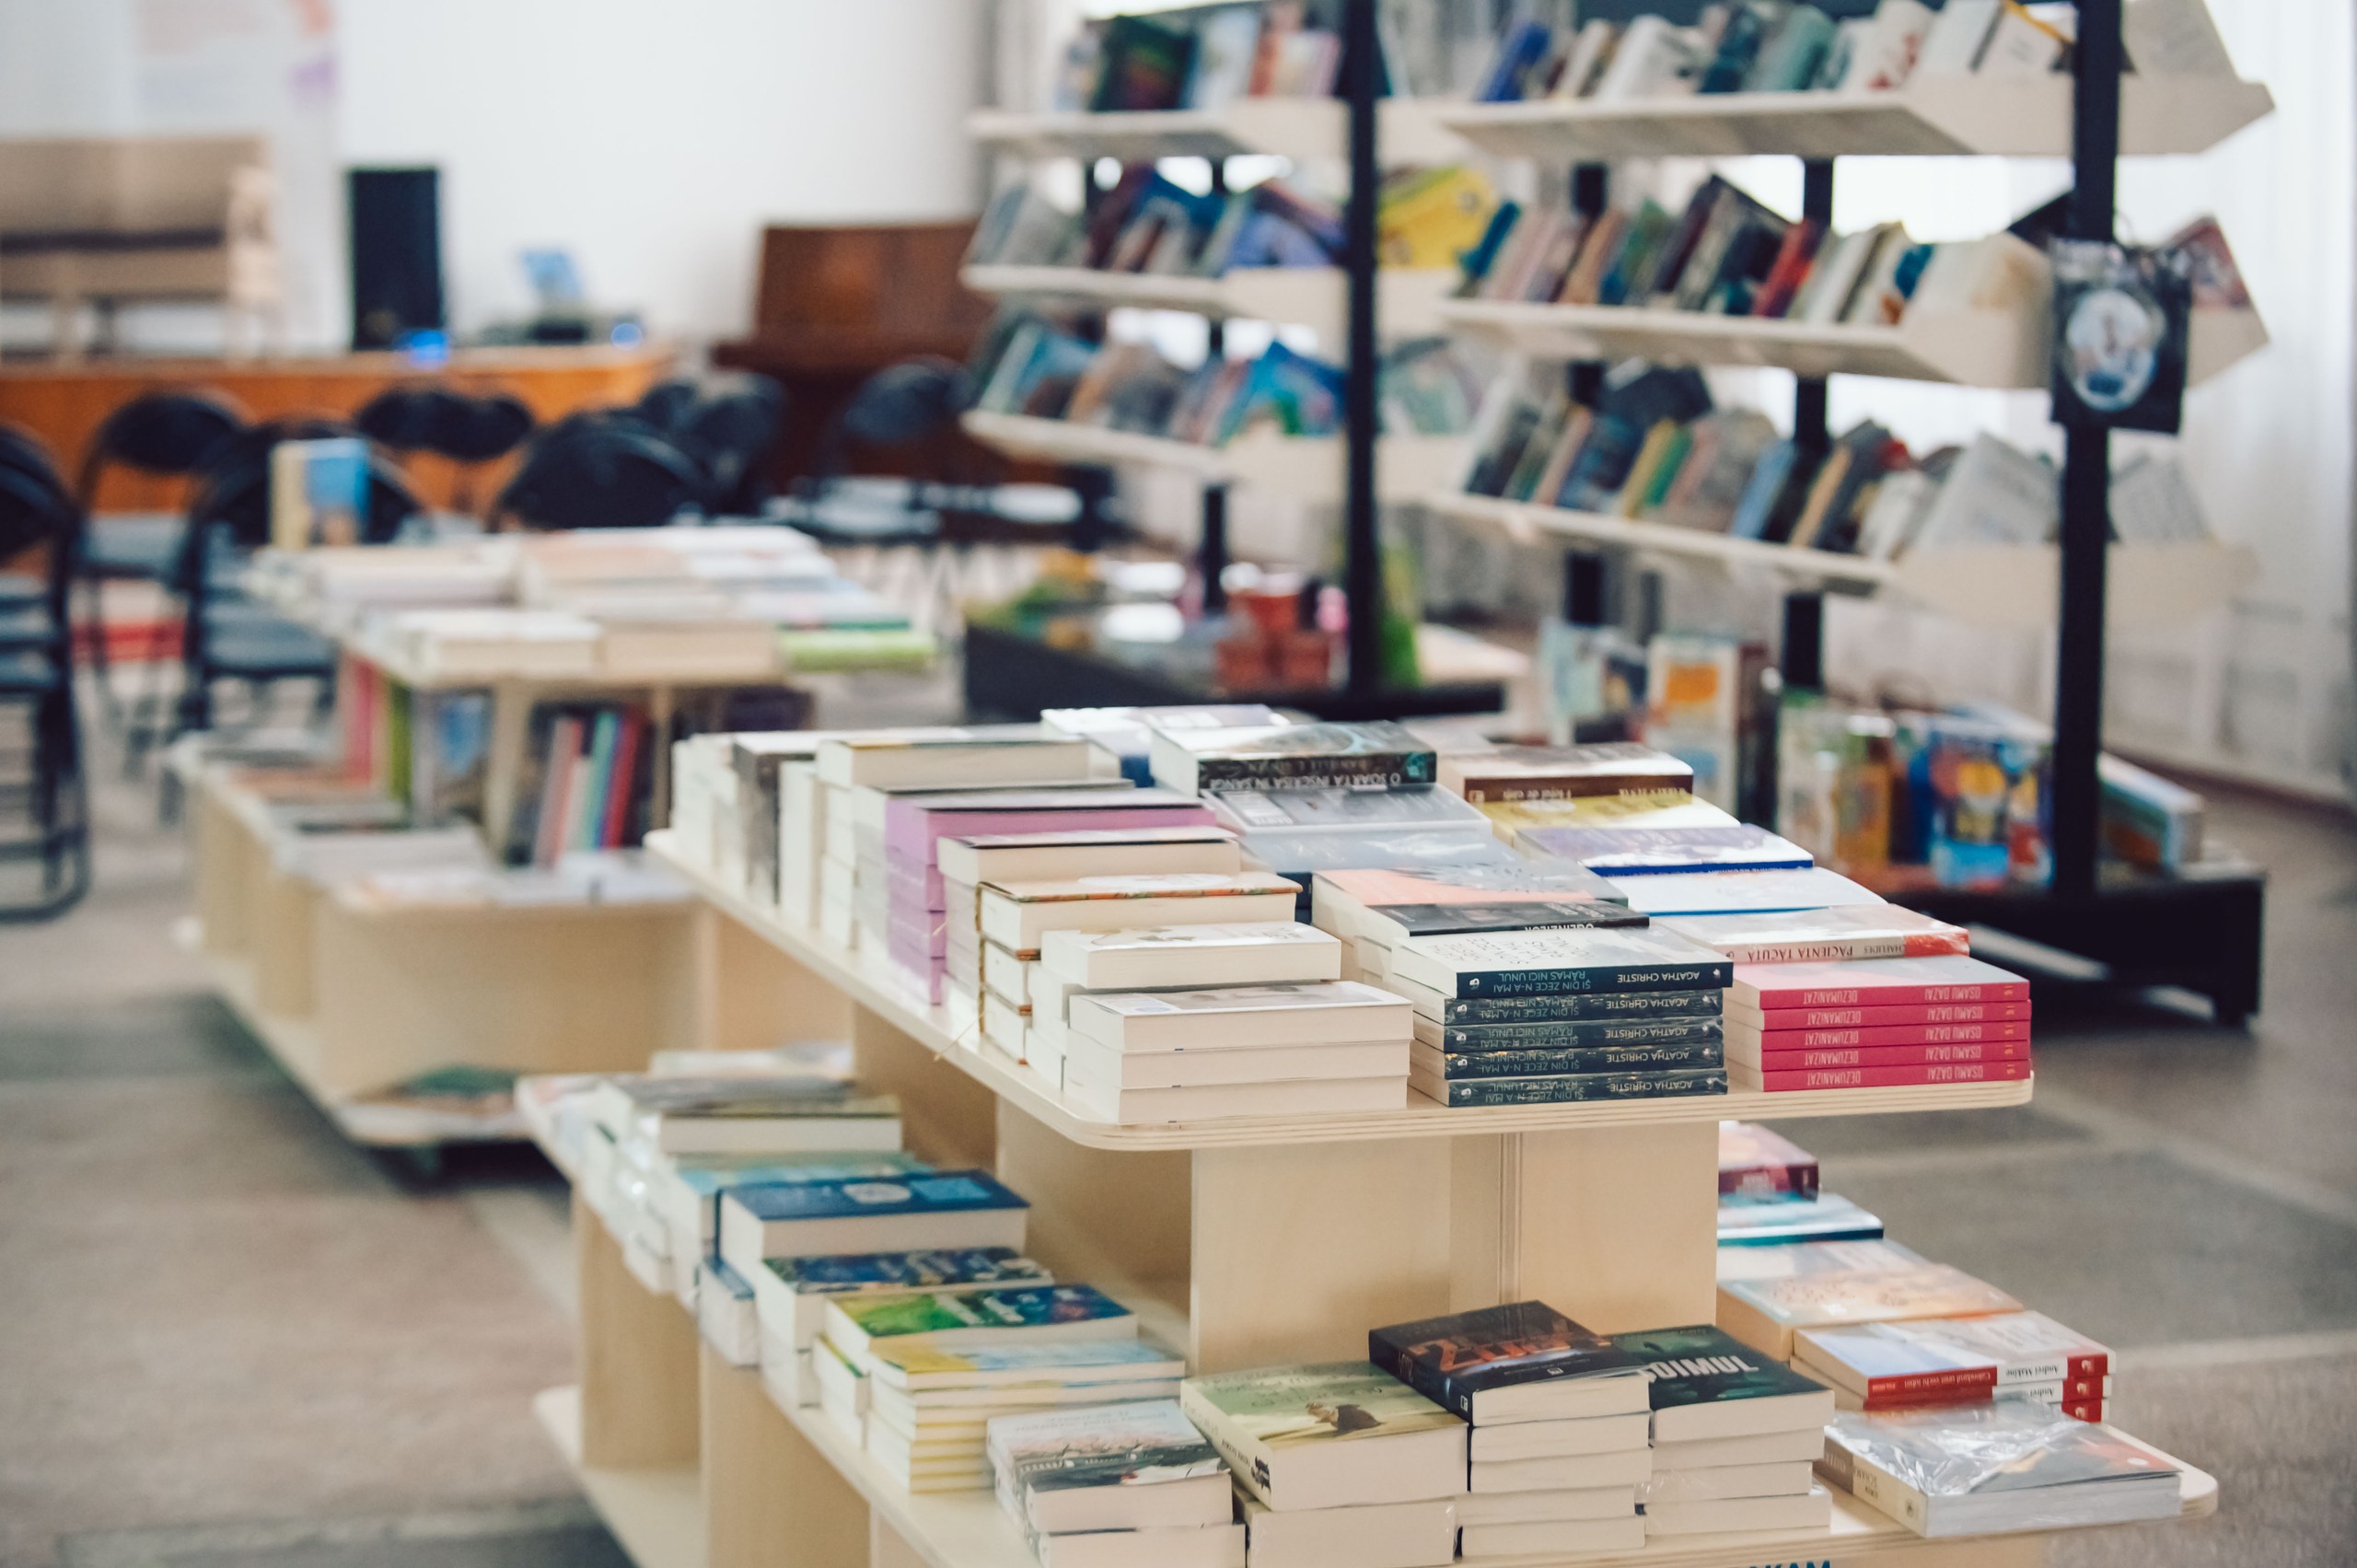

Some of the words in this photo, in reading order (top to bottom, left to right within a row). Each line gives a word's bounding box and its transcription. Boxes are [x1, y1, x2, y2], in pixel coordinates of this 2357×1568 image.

[1499, 973, 1526, 981] UNUL
[1528, 972, 1548, 981] NICI
[1617, 973, 1659, 982] CHRISTIE
[1661, 971, 1700, 981] AGATHA
[1493, 984, 1511, 993] MAI
[1536, 981, 1560, 991] ZECE
[1562, 981, 1579, 990] DIN
[1804, 990, 1858, 1005] DEZUMANIZAT
[1924, 988, 1950, 1002] DAZAI
[1952, 986, 1981, 1000] OSAMU
[1606, 999, 1648, 1009] CHRISTIE
[1650, 998, 1689, 1007] AGATHA
[1523, 1008, 1548, 1017] ZECE
[1927, 1007, 1952, 1021] DAZAI
[1956, 1005, 1983, 1020] OSAMU
[1807, 1010, 1861, 1026] DEZUMANIZAT
[1606, 1028, 1647, 1039] CHRISTIE
[1650, 1028, 1689, 1037] AGATHA
[1926, 1028, 1950, 1040] DAZAI
[1954, 1026, 1981, 1040] OSAMU
[1805, 1031, 1859, 1046] DEZUMANIZAT
[1481, 1040, 1499, 1048] MAI
[1651, 1051, 1689, 1061] AGATHA
[1926, 1047, 1950, 1061] DAZAI
[1954, 1045, 1981, 1060] OSAMU
[1607, 1053, 1648, 1063] CHRISTIE
[1805, 1051, 1859, 1066] DEZUMANIZAT
[1482, 1064, 1499, 1073] MAI
[1523, 1063, 1548, 1071] ZECE
[1550, 1062, 1567, 1070] DIN
[1928, 1066, 1952, 1080] DAZAI
[1956, 1064, 1983, 1079] OSAMU
[1806, 1070, 1861, 1086] DEZUMANIZAT
[1609, 1082, 1652, 1092] CHRISTIE
[1654, 1081, 1692, 1089] AGATHA
[1554, 1090, 1571, 1099] DIN
[1647, 1355, 1759, 1382] OIMUL
